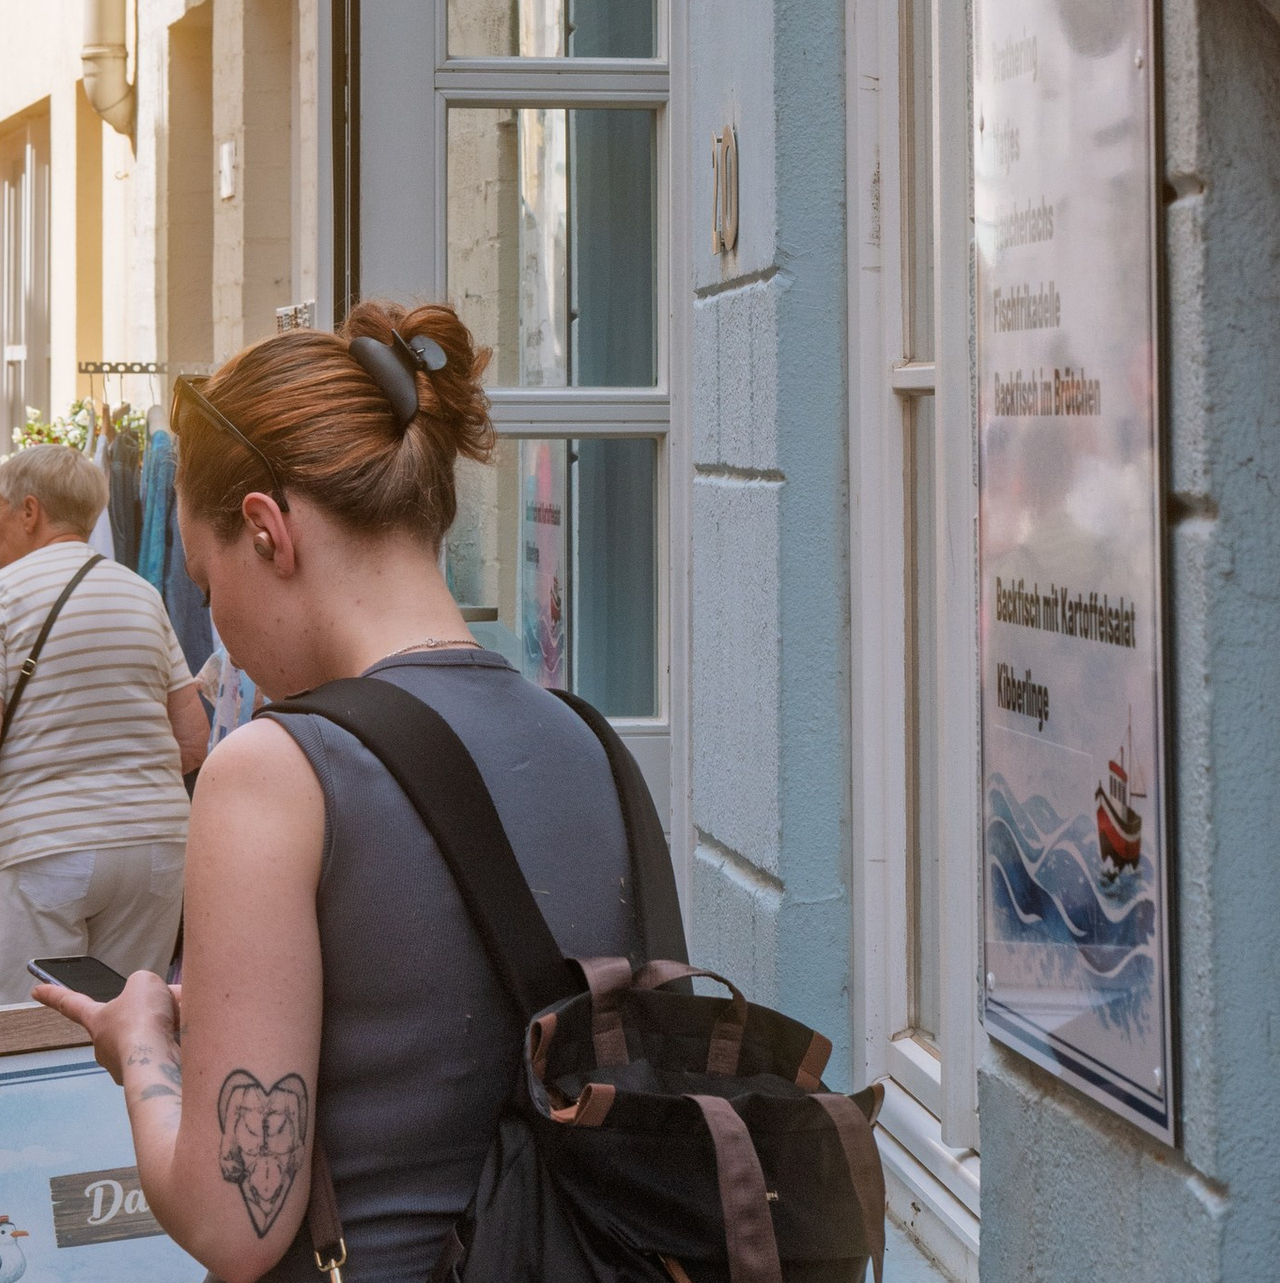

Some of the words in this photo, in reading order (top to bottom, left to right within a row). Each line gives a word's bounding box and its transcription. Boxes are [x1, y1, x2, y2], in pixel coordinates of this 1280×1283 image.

[993, 279, 1061, 333] Fischfrikadelle
[994, 368, 1039, 417] Backfisch
[1039, 366, 1053, 417] im
[1054, 366, 1101, 417] Brötchen
[996, 576, 1040, 629] Backfisch
[1042, 582, 1059, 633] mit
[1061, 587, 1136, 649] Kartoffelsalat
